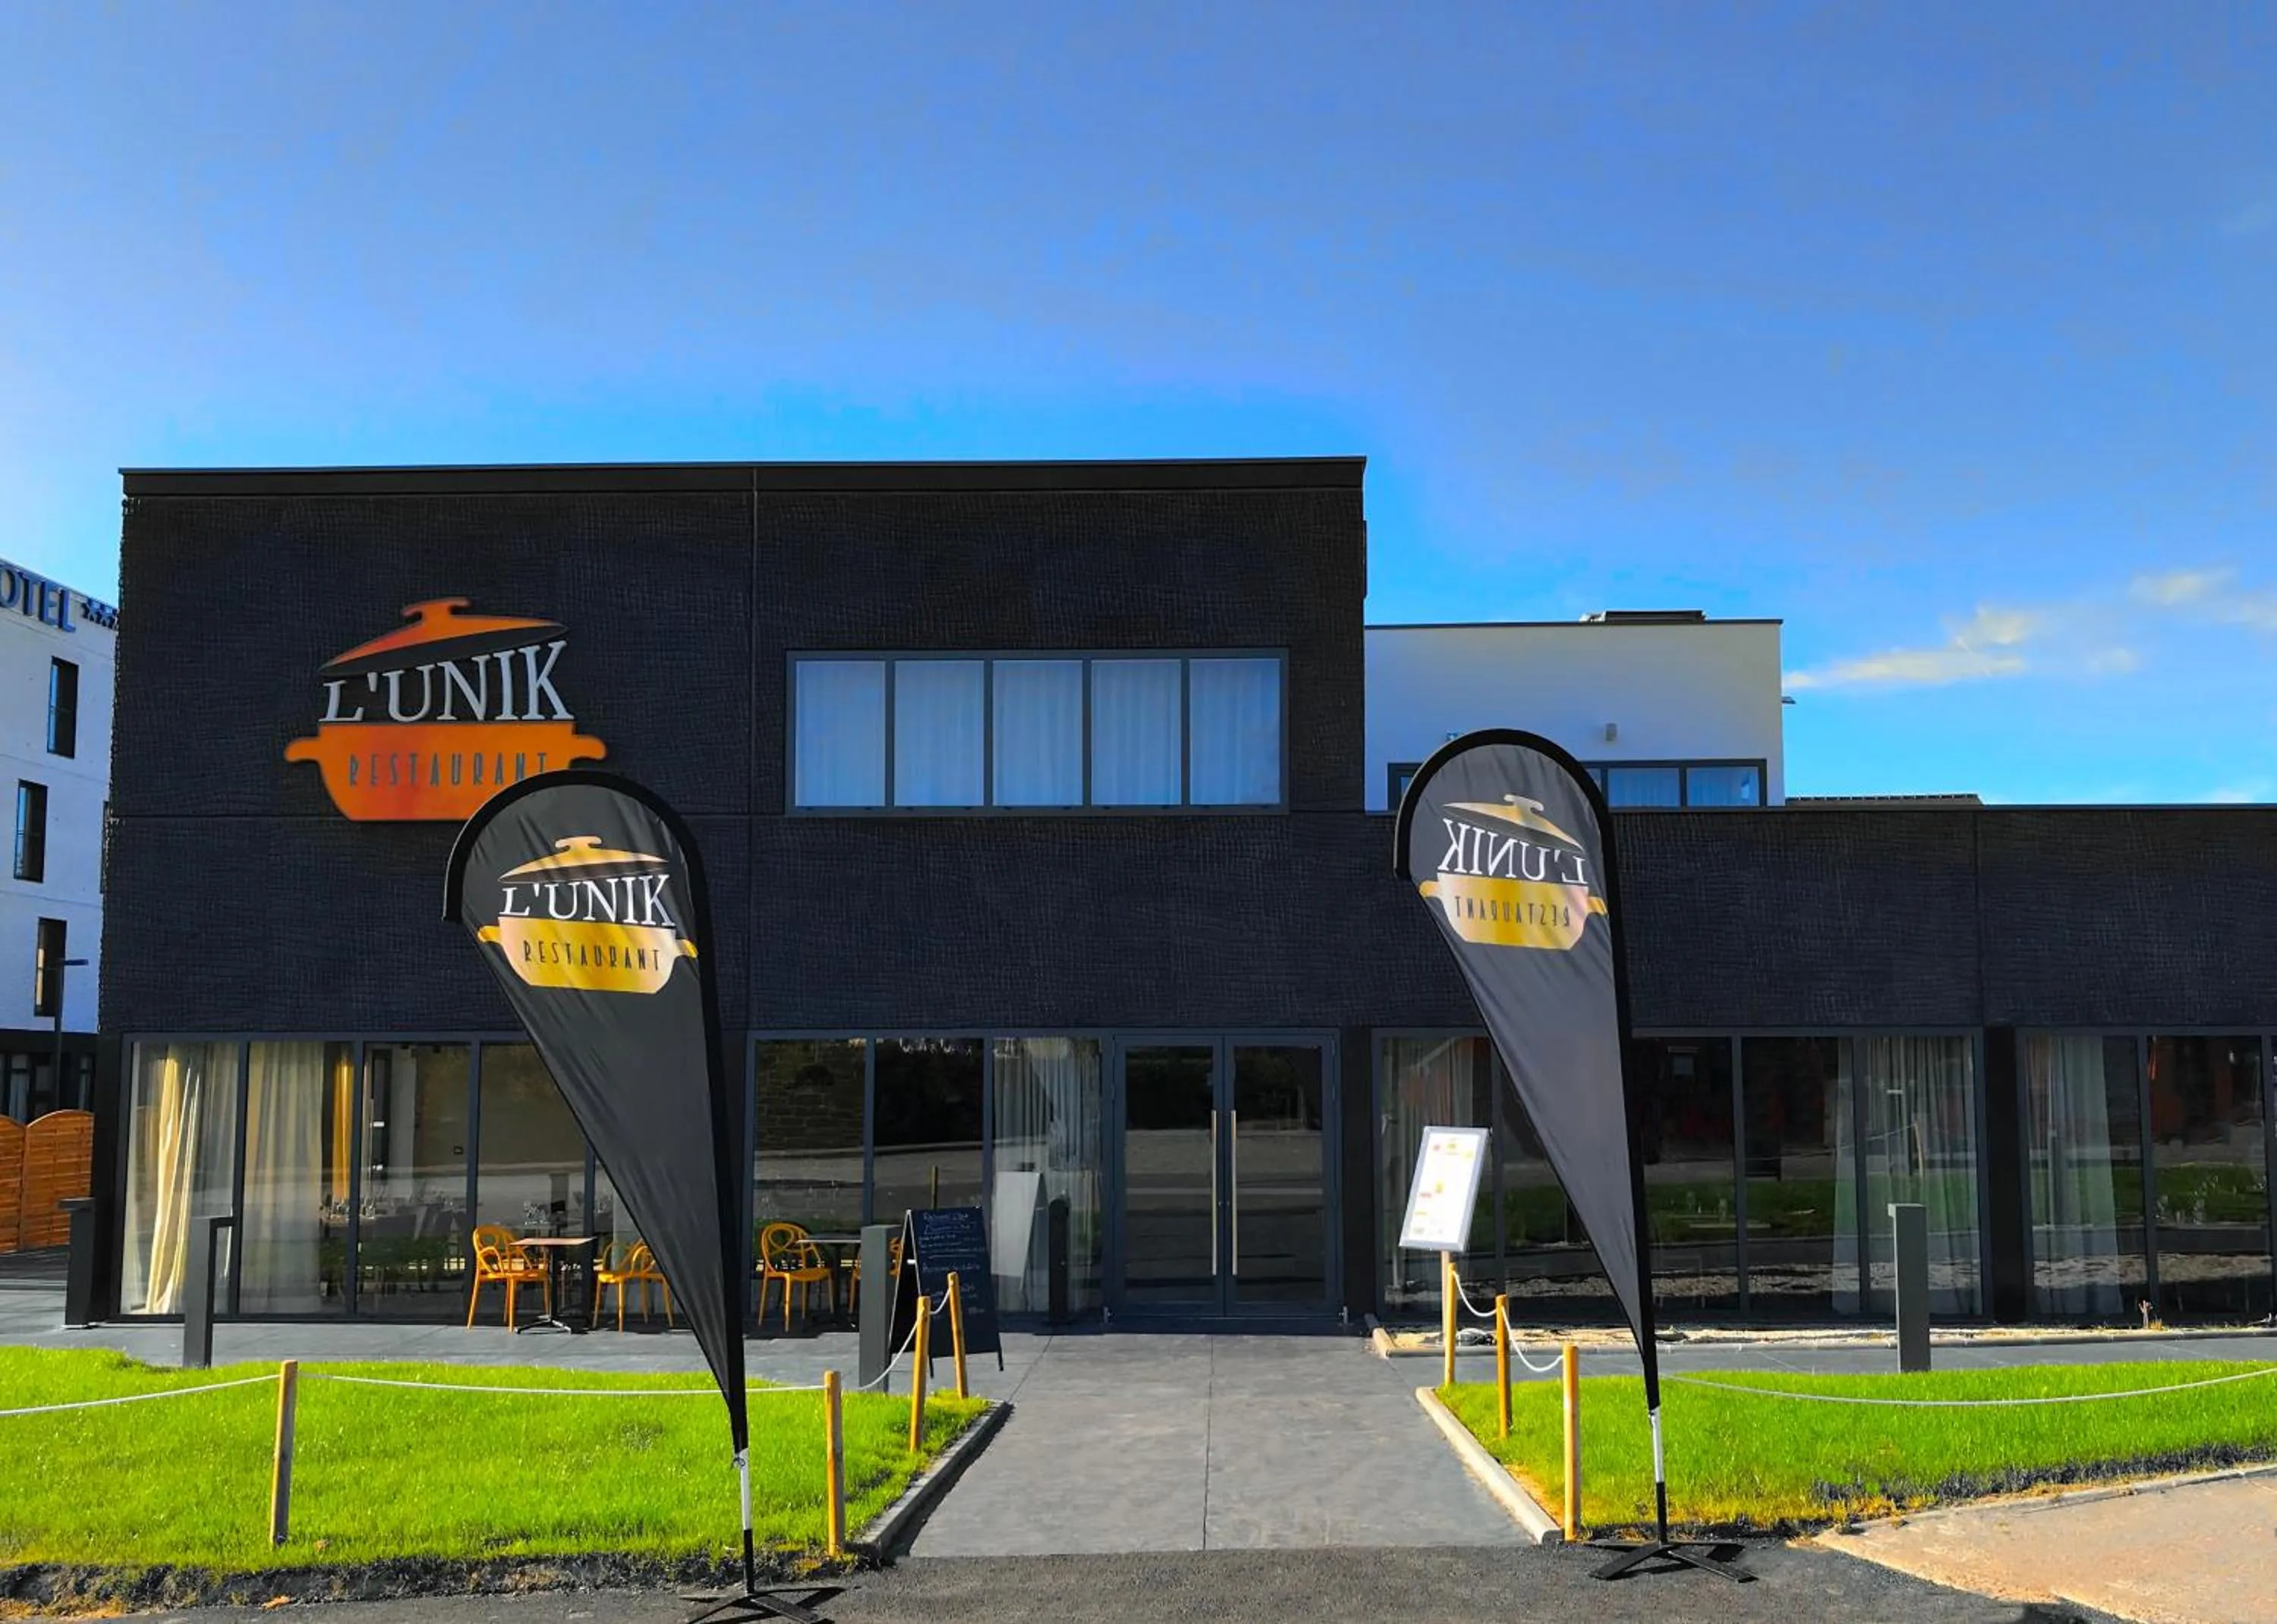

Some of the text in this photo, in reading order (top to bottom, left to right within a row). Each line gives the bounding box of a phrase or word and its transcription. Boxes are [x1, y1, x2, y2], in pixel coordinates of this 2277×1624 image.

[318, 640, 575, 722] L'UNIK
[349, 752, 547, 788] RESTAURANT
[499, 873, 676, 927] L'UNIK
[523, 939, 661, 971] RESTAURANT
